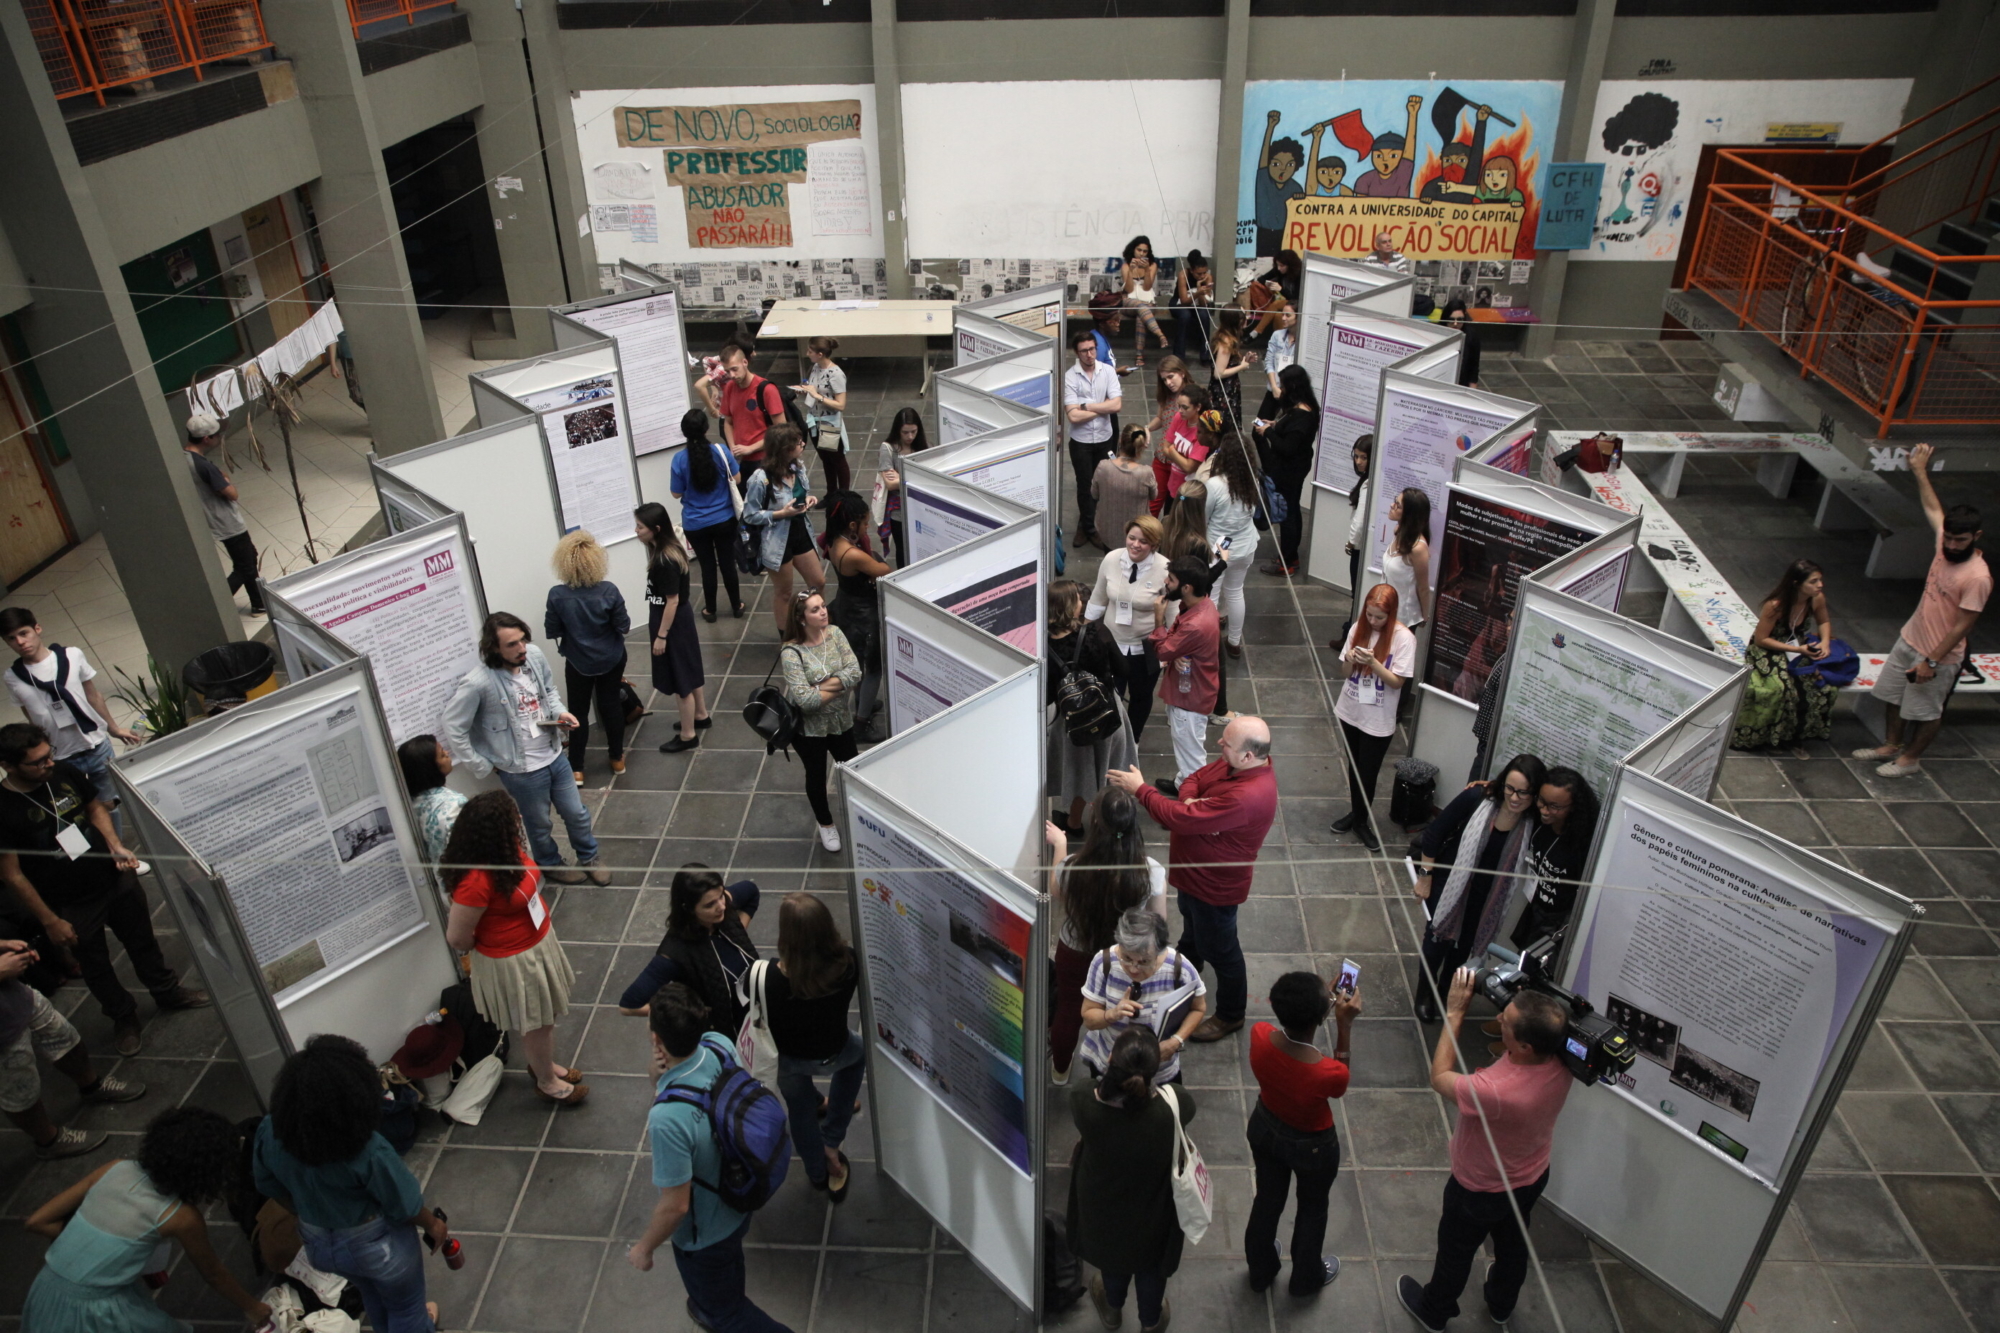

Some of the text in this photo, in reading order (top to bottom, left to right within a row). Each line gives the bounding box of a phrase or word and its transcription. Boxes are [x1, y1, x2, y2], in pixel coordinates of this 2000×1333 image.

[625, 109, 861, 143] DE NOVO, SOCIOLOGIA?
[668, 150, 807, 175] PROFESSOR
[1552, 171, 1594, 188] CFH
[688, 183, 785, 210] ABUSADOR
[1564, 191, 1581, 206] DE
[713, 208, 745, 224] NÃO
[1296, 204, 1519, 224] CONTRA A UNIVERSIDADE DO CAPITAL
[1546, 208, 1584, 224] LUTA
[697, 219, 791, 246] PASSARÁ!!!
[1236, 227, 1253, 236] CFH
[1236, 236, 1252, 245] 2016
[1437, 223, 1513, 254] SOCIAL
[961, 334, 975, 352] MM
[1340, 333, 1364, 348] MM
[1456, 501, 1474, 512] Modos
[1481, 510, 1513, 524] subjetivação
[1513, 519, 1523, 527] das
[1523, 523, 1558, 539] profissionais
[1558, 533, 1566, 541] do
[1460, 509, 1478, 520] mulher
[1491, 519, 1517, 533] prostituta
[1525, 529, 1542, 541] região
[1508, 531, 1534, 545] Recife/PE
[425, 551, 453, 578] MM
[351, 574, 391, 595] movimentos
[391, 565, 416, 579] sociais,
[342, 593, 367, 607] política
[374, 576, 414, 595] visibilidades
[979, 595, 988, 603] uma
[988, 591, 999, 599] moça
[328, 616, 347, 629] Aguiar
[898, 636, 914, 658] MM
[865, 819, 886, 838] UFU
[856, 843, 891, 866] INTRODUÇÃO
[1630, 832, 1777, 912] dos papéis femininos na cultura.
[1633, 823, 1666, 844] Gênero
[1675, 844, 1707, 865] cultura
[1708, 861, 1760, 892] pomerana:
[1761, 888, 1798, 911] Análise
[1800, 908, 1813, 919] de
[1815, 915, 1868, 947] narrativas
